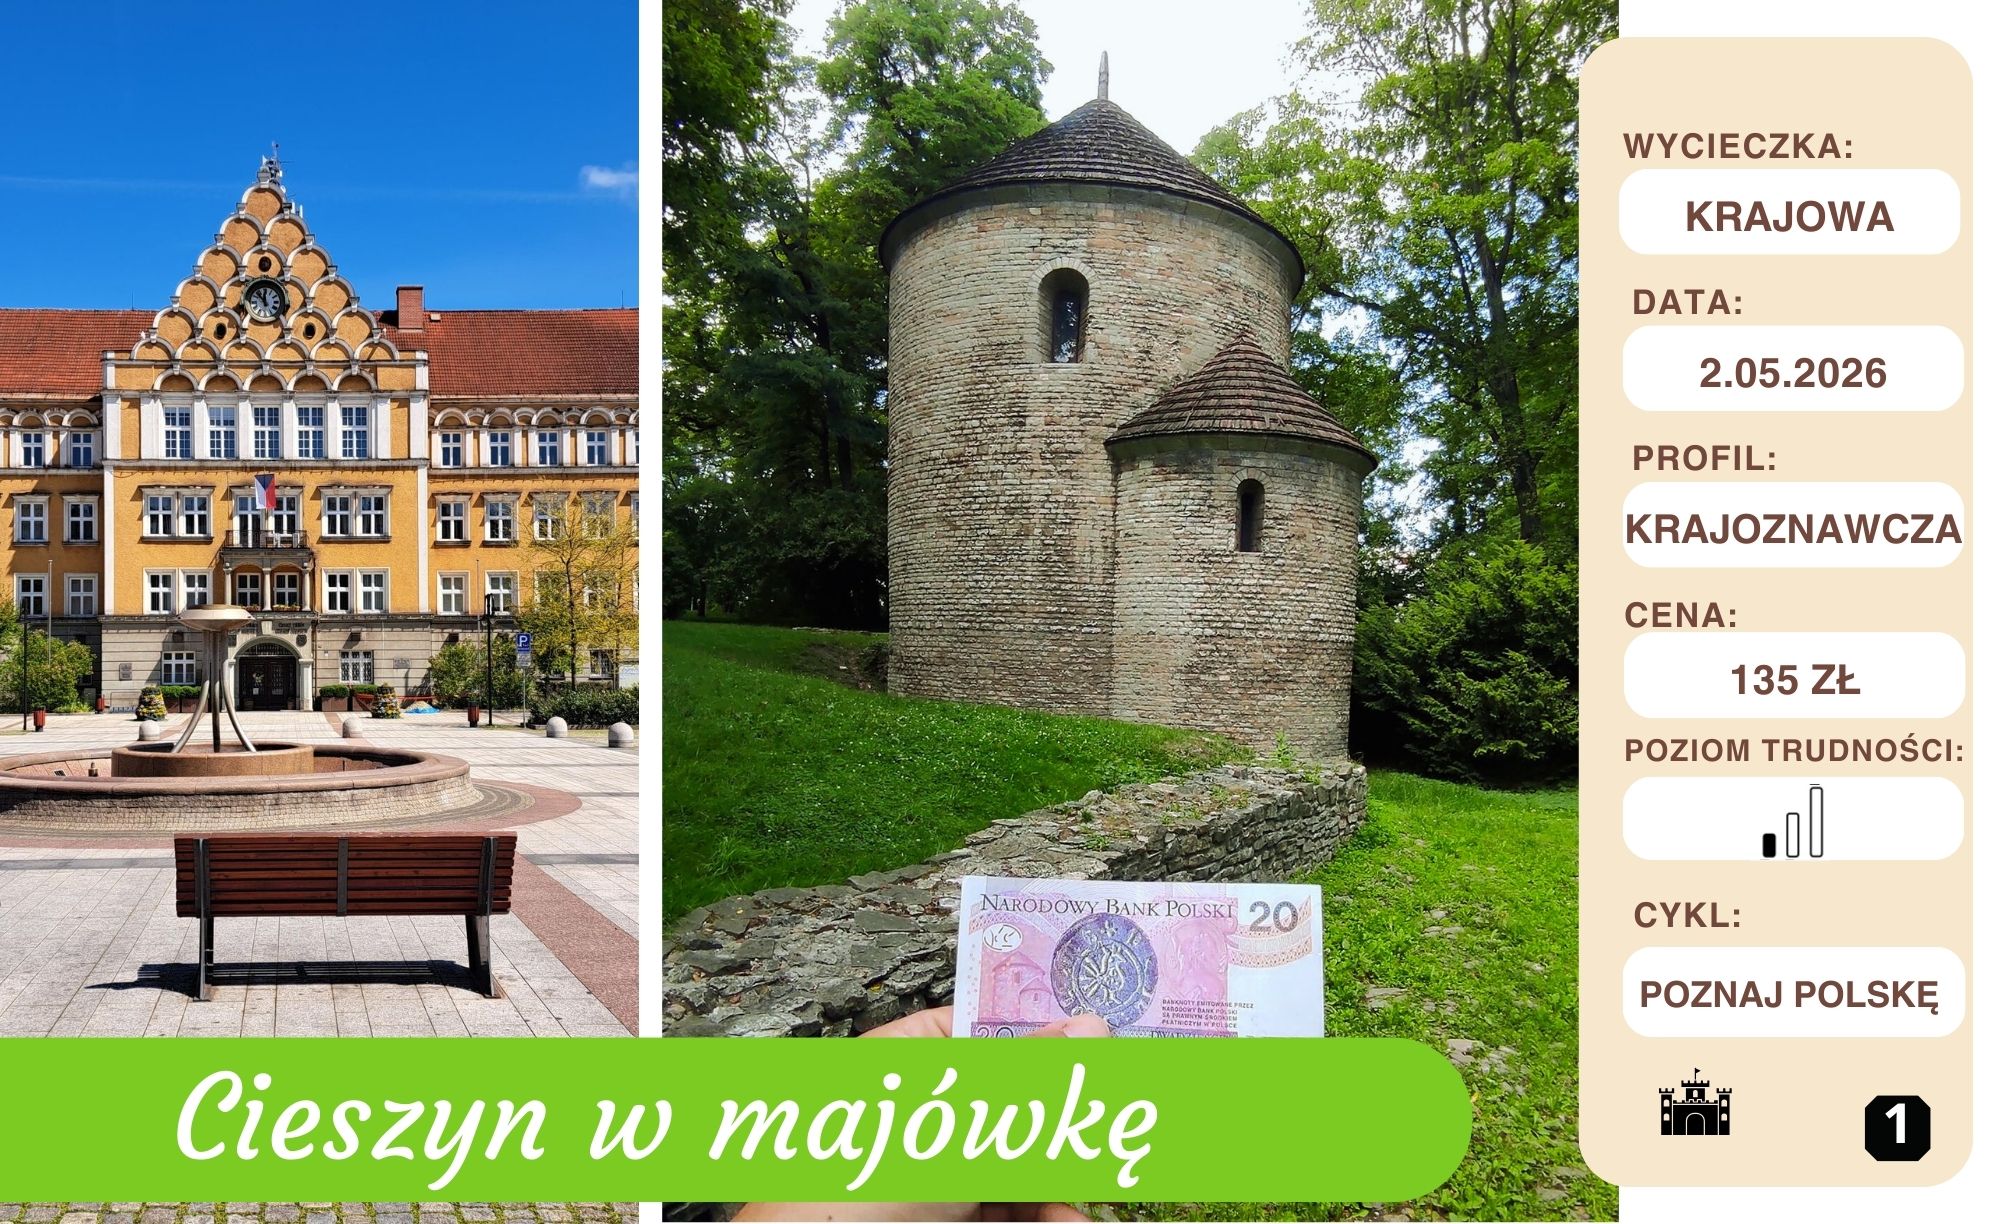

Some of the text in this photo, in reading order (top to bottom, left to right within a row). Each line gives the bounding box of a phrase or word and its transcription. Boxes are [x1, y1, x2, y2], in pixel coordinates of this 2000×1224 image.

[980, 894, 1233, 918] NARODOWY BANK POLSKI
[1249, 900, 1300, 933] 20
